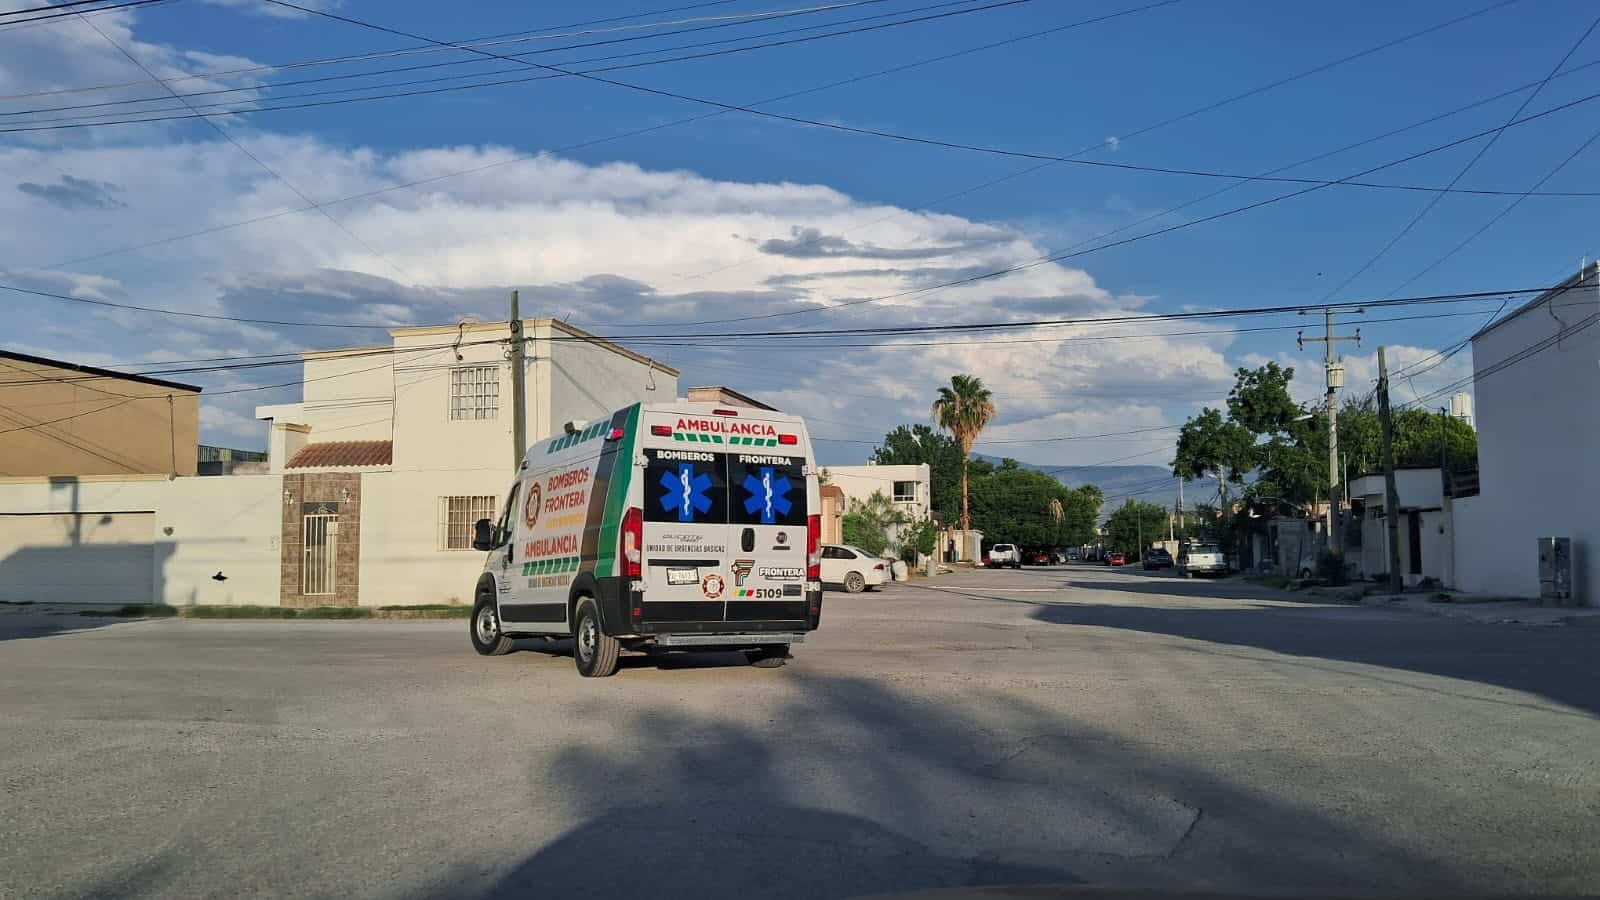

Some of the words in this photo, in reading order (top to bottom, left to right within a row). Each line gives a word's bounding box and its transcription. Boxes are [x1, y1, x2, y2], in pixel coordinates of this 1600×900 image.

[677, 419, 777, 436] AMBULANCIA
[657, 450, 715, 462] BOMBEROS
[739, 455, 792, 466] FRONTERA
[547, 467, 589, 492] BOMBEROS
[544, 490, 585, 512] FRONTERA
[524, 535, 578, 559] AMBULANCIA
[759, 567, 805, 578] FRONTERA
[756, 588, 782, 598] 5109
